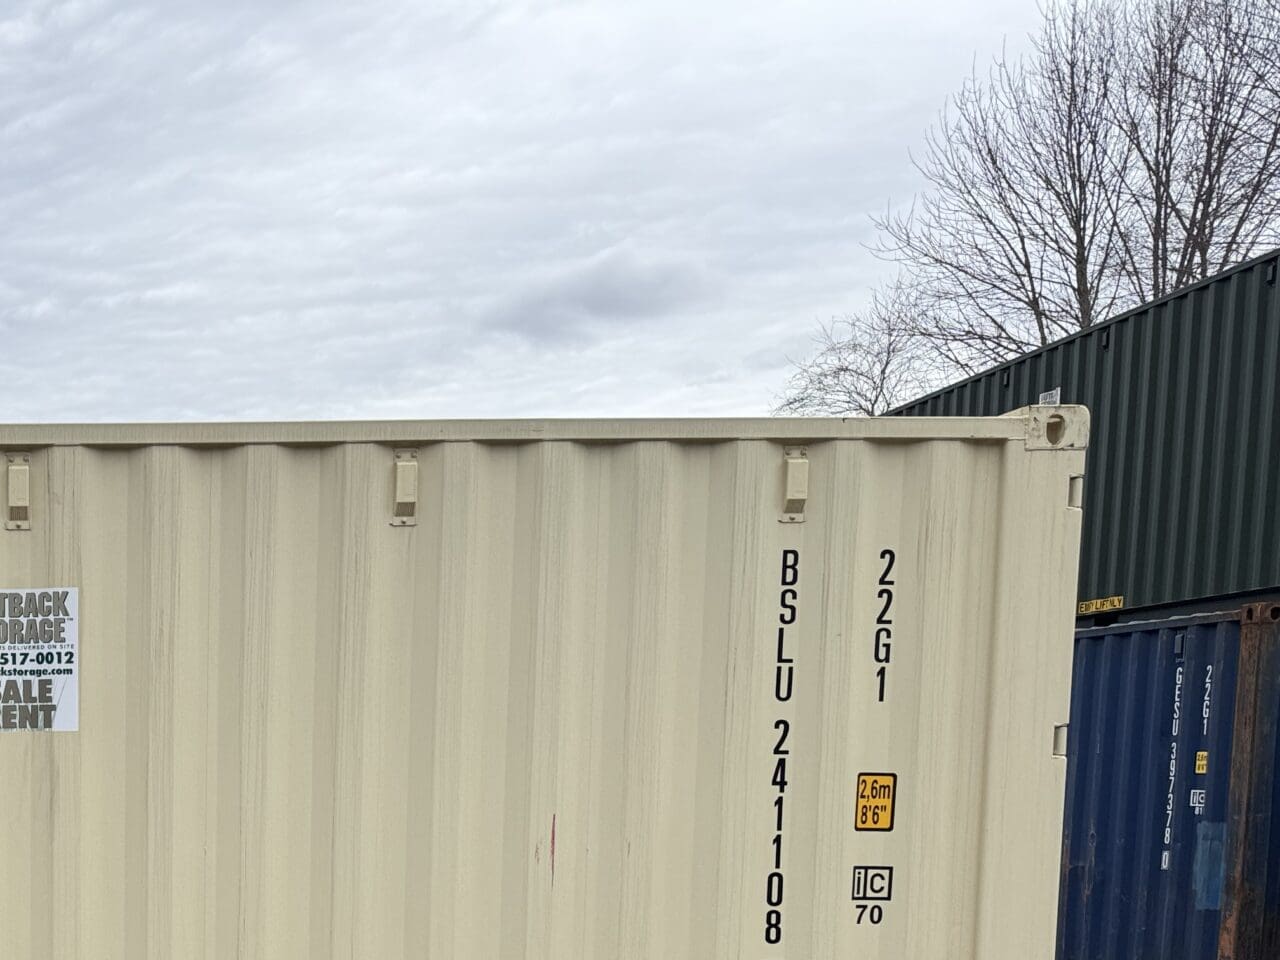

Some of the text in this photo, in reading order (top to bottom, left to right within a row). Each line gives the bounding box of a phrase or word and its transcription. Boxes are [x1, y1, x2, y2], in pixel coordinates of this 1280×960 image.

[775, 549, 800, 702] BSLU
[873, 549, 896, 702] 22G1
[1172, 667, 1183, 736] GESU
[1203, 665, 1213, 735] 22G1
[764, 719, 790, 945] 241108
[860, 805, 887, 825] 8'6"
[1164, 742, 1177, 844] 397378
[855, 904, 884, 925] 70
